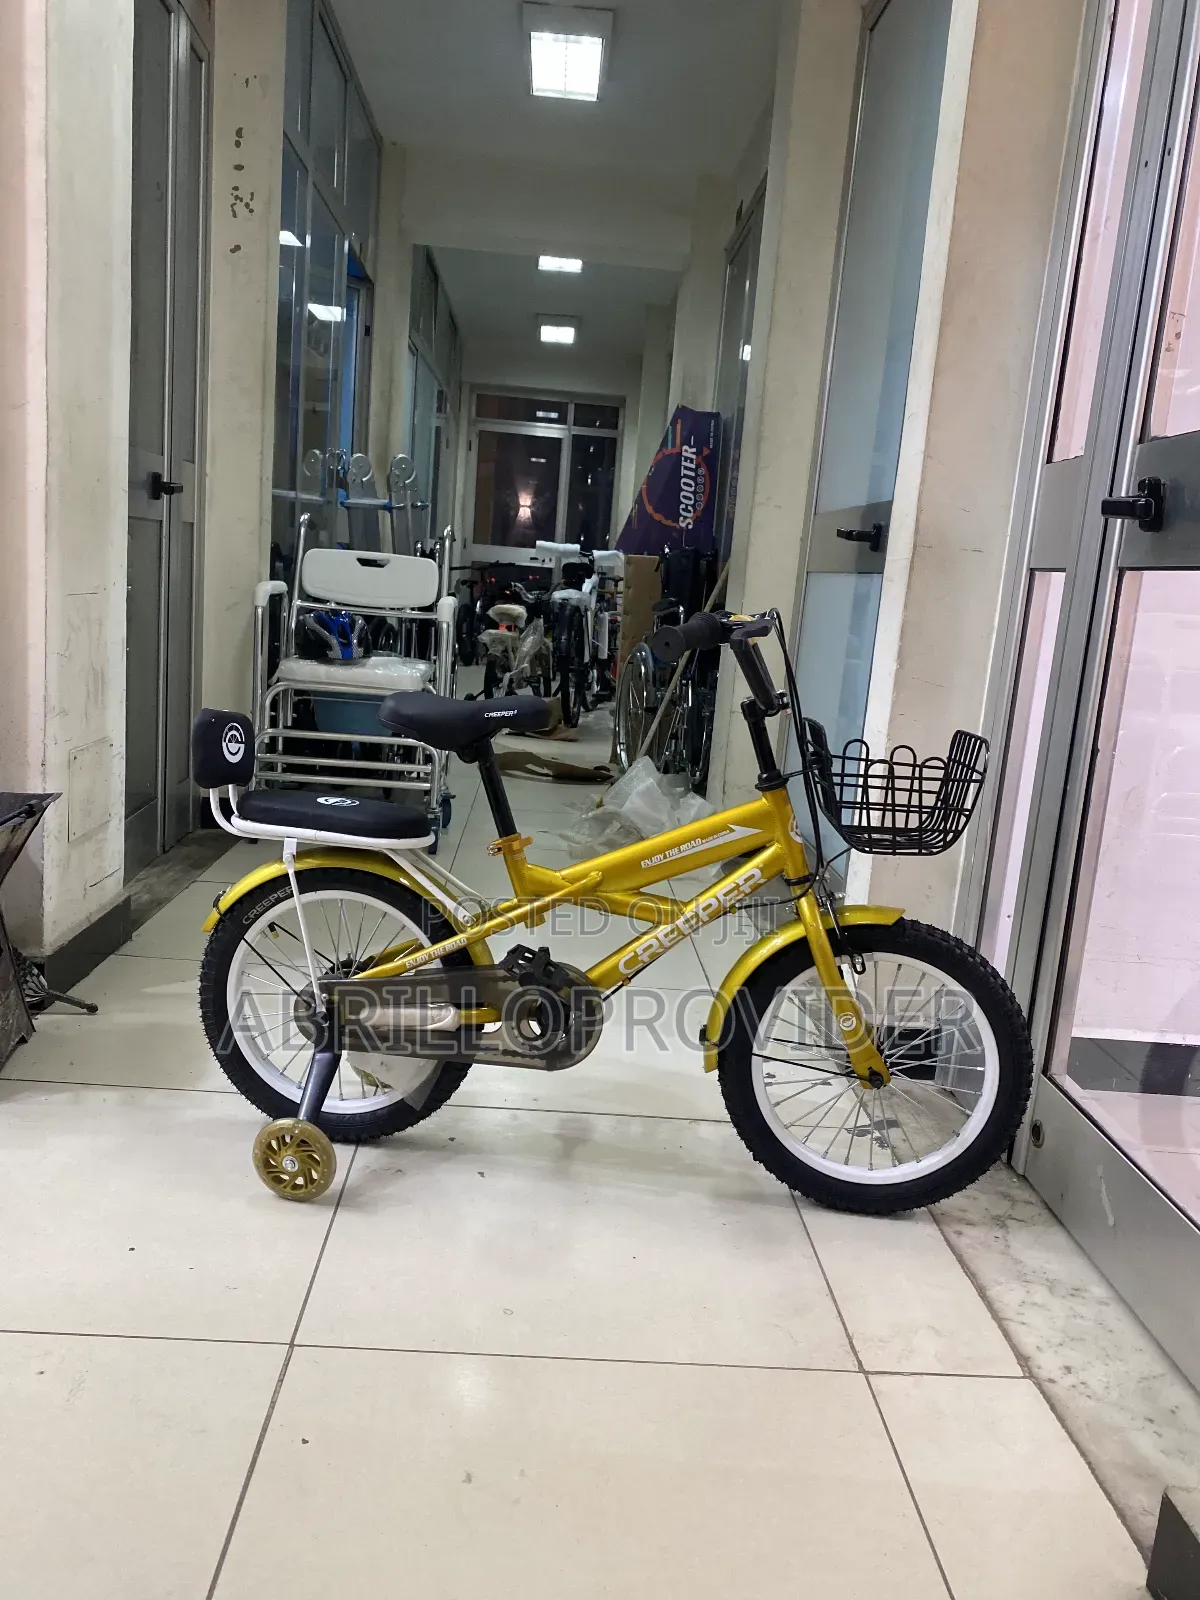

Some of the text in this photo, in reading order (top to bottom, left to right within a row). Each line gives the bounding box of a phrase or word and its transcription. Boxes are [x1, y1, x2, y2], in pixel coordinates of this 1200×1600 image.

[679, 444, 697, 530] SCOOTER
[641, 852, 665, 868] ENJOY
[665, 846, 680, 858] THE
[680, 837, 702, 853] ROAD
[618, 867, 767, 975] CREEPER
[406, 937, 467, 969] ENJOY THE ROAD
